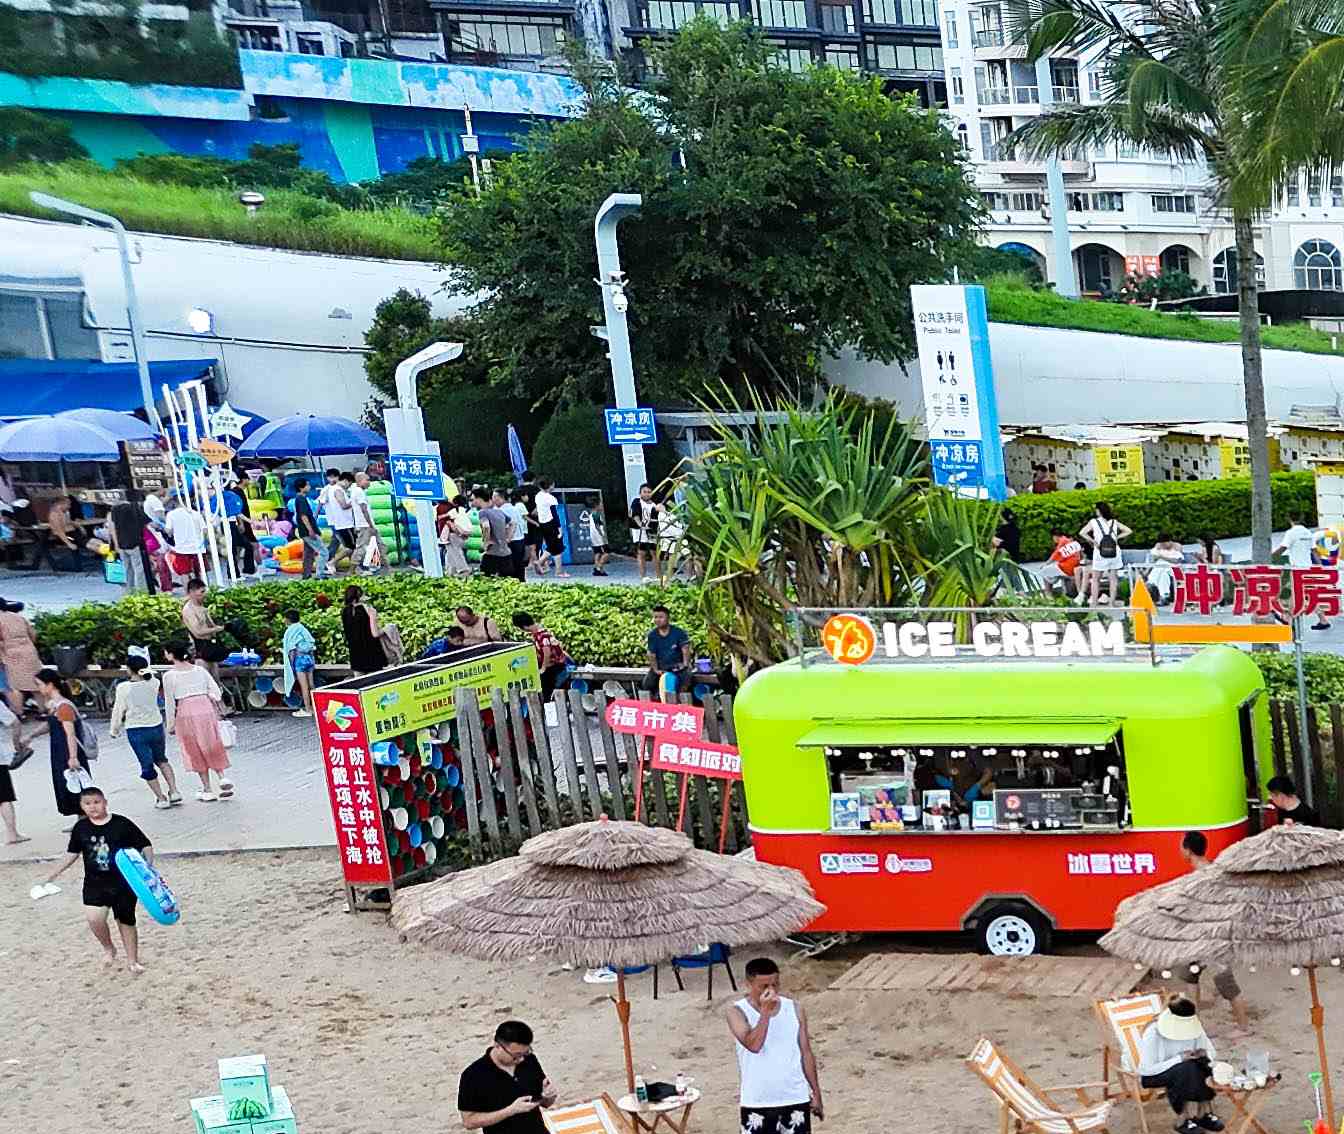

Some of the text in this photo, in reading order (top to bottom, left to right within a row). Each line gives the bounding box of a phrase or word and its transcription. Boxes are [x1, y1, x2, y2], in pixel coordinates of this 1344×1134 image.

[918, 312, 964, 323] 公共洗手间
[935, 443, 979, 464] 冲凉房
[394, 459, 438, 477] 冲凉房
[1172, 565, 1343, 617] 冲凉房
[882, 621, 1127, 658] ICE CREAM
[611, 704, 697, 733] 福市集
[349, 747, 383, 865] 防止水中被抢
[1068, 853, 1156, 874] 冰雪世界
